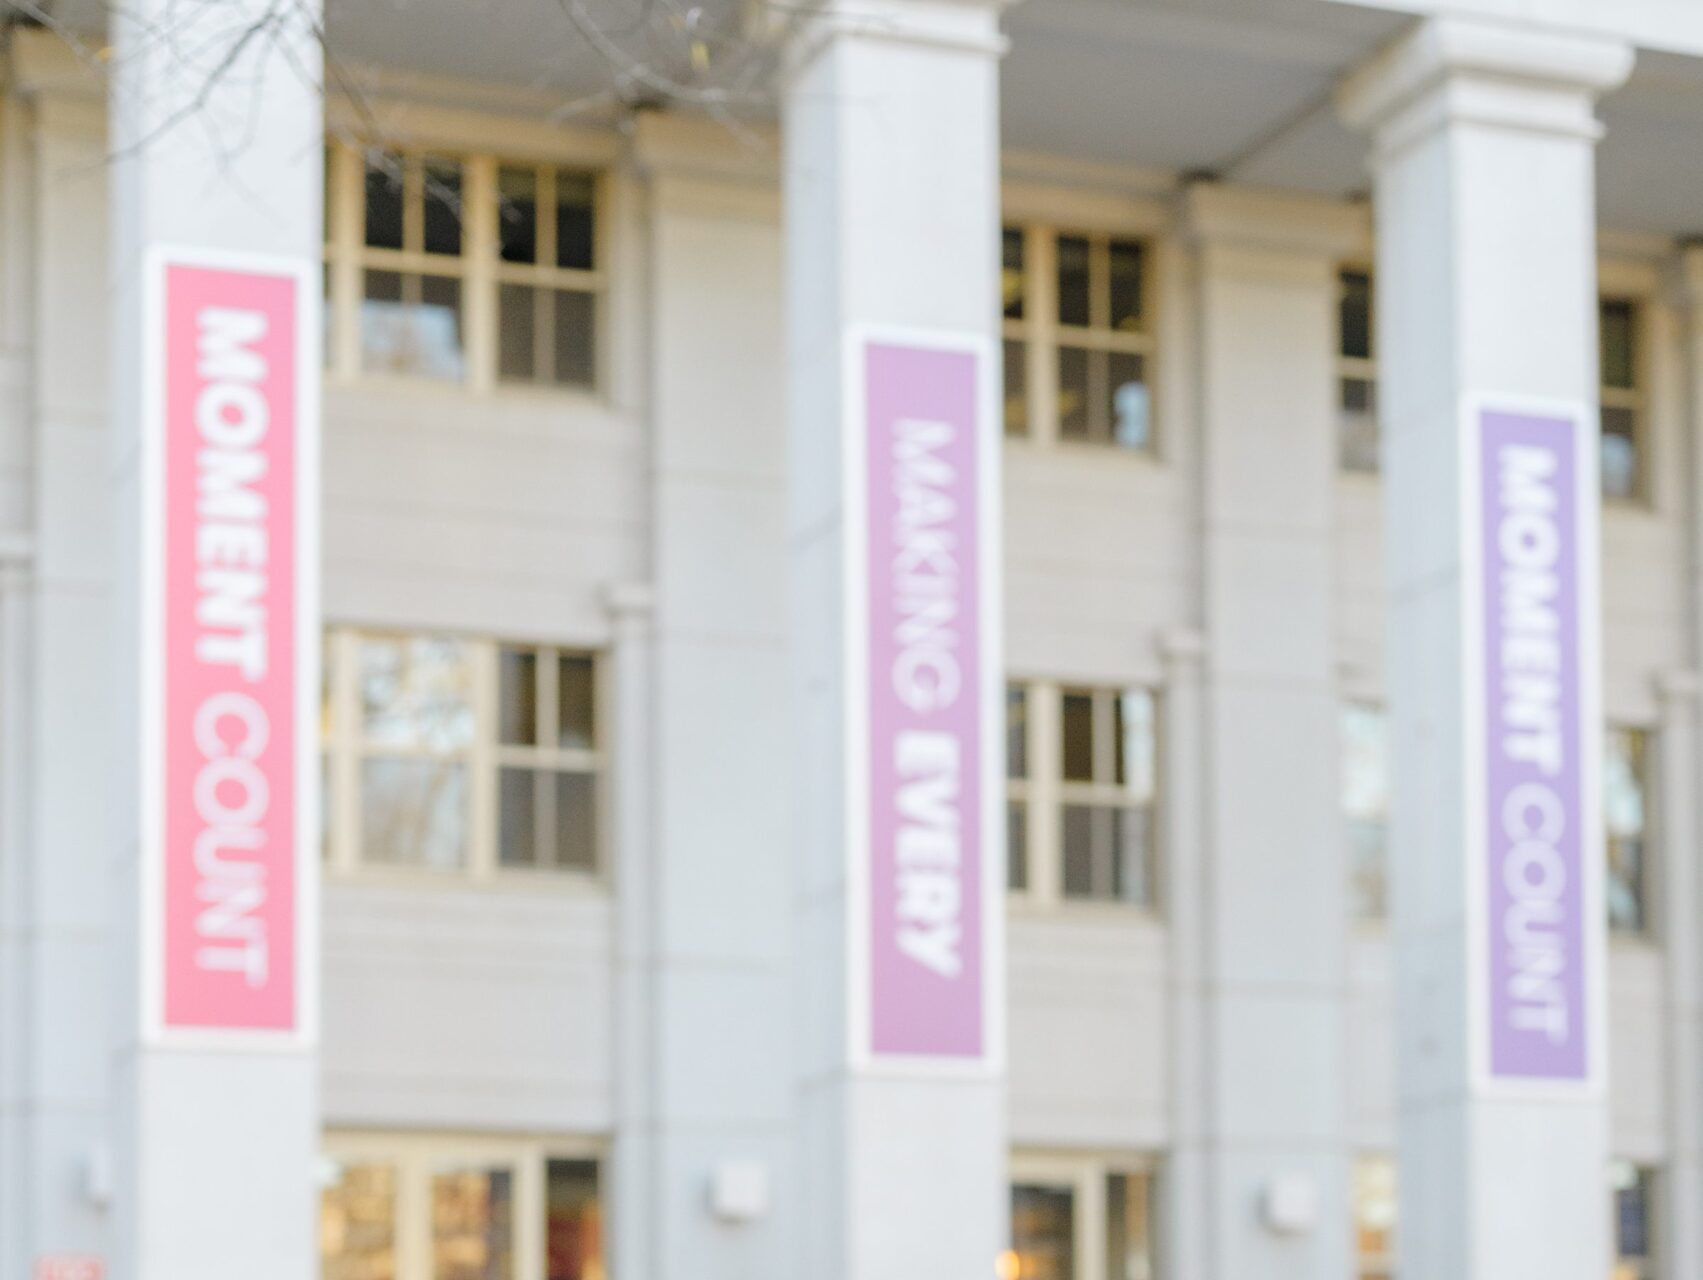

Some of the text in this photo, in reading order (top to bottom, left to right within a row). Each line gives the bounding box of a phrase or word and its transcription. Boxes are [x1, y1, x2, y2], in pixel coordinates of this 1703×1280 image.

[193, 307, 270, 989] MOMENT COUNT
[891, 416, 962, 979] MAKING EVERY
[1498, 441, 1568, 1047] MOMENT COUNT
